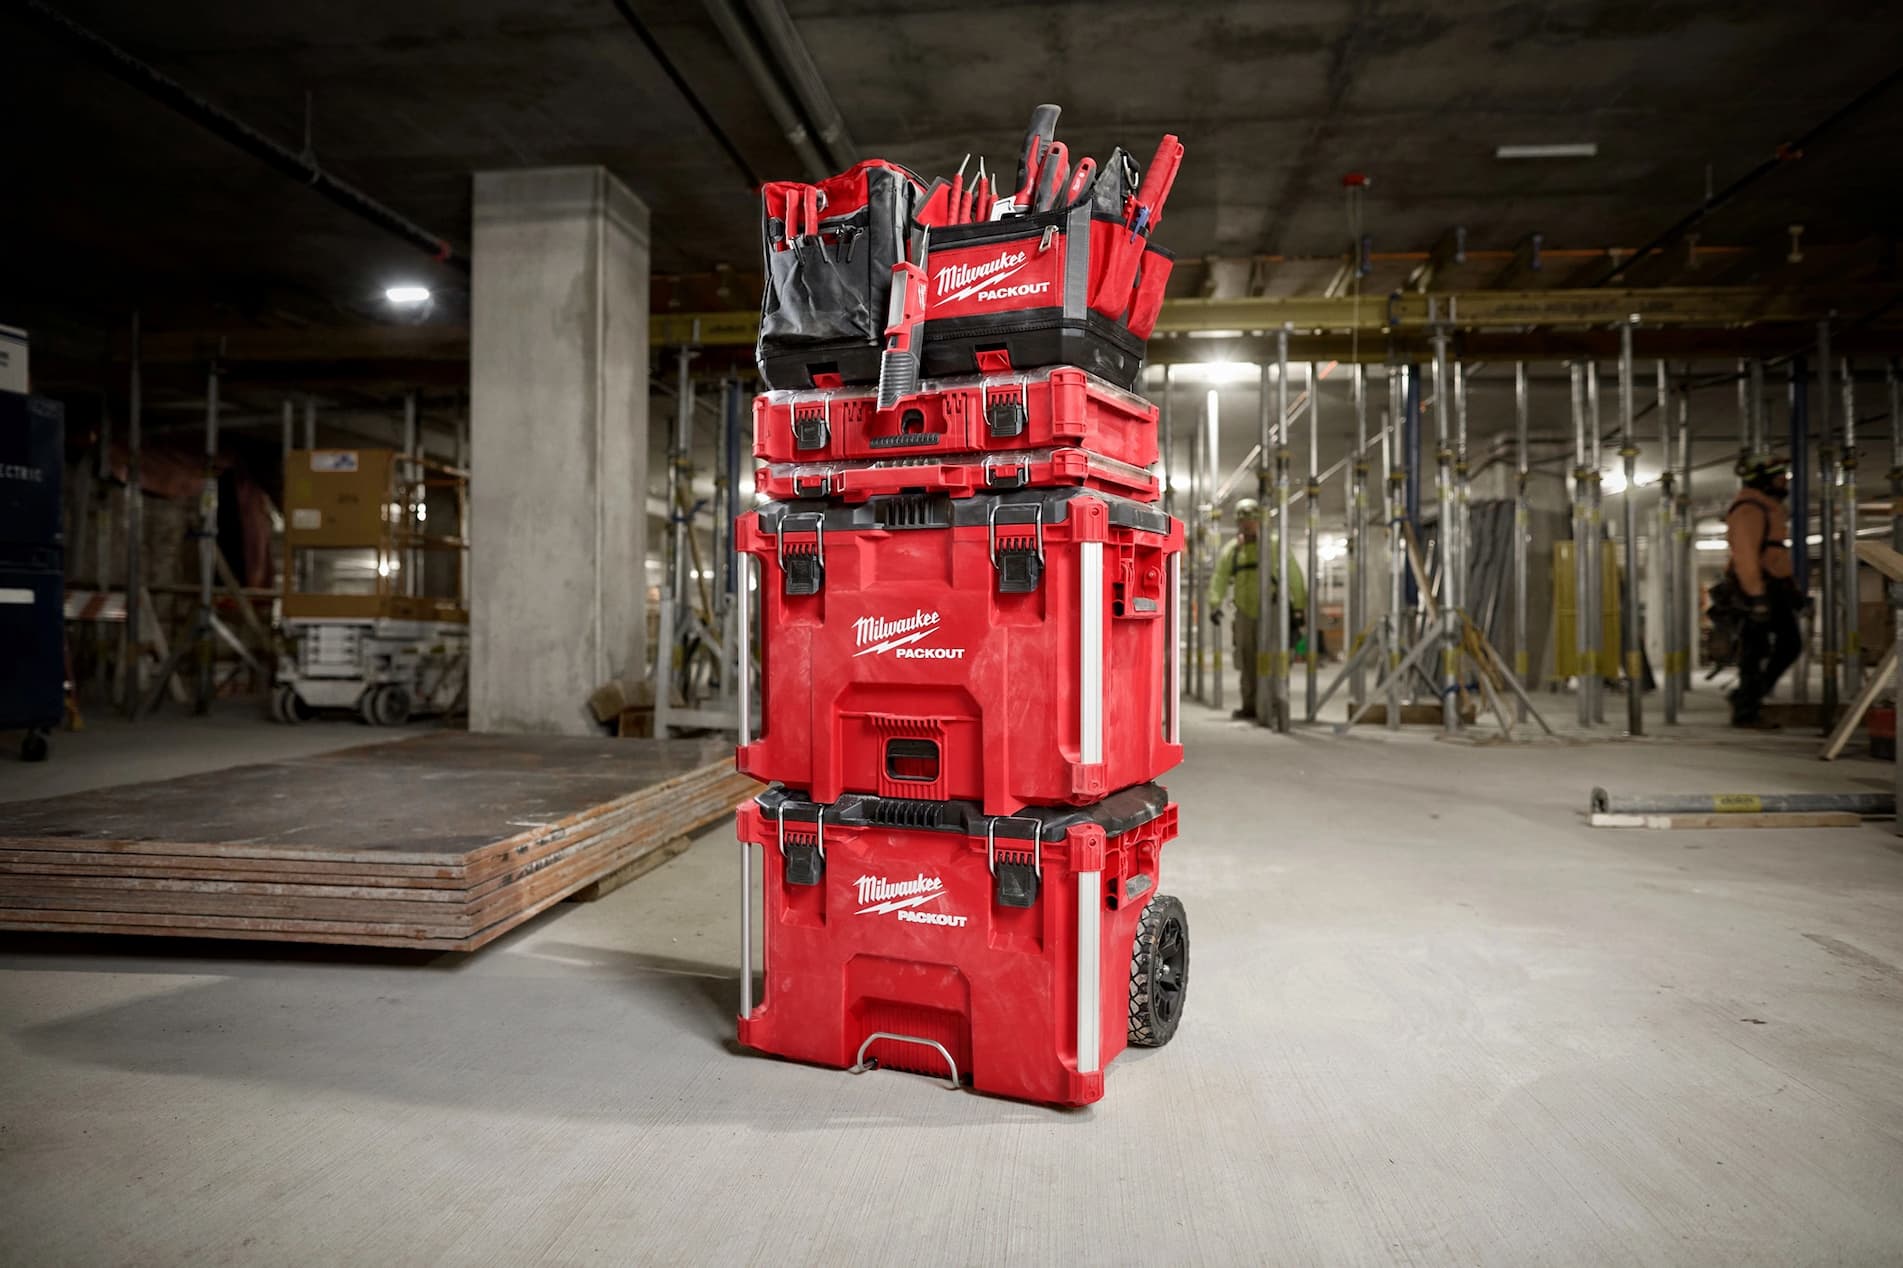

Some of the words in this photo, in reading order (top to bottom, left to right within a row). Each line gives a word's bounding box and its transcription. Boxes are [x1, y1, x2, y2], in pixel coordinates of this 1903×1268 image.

[933, 251, 1026, 296] Milwaukee
[978, 282, 1050, 301] PACKOUT
[851, 609, 940, 647] Milwaukee
[896, 648, 965, 659] PACKOUT
[853, 873, 943, 905] Milwaukee
[898, 910, 967, 927] PACKOUT
